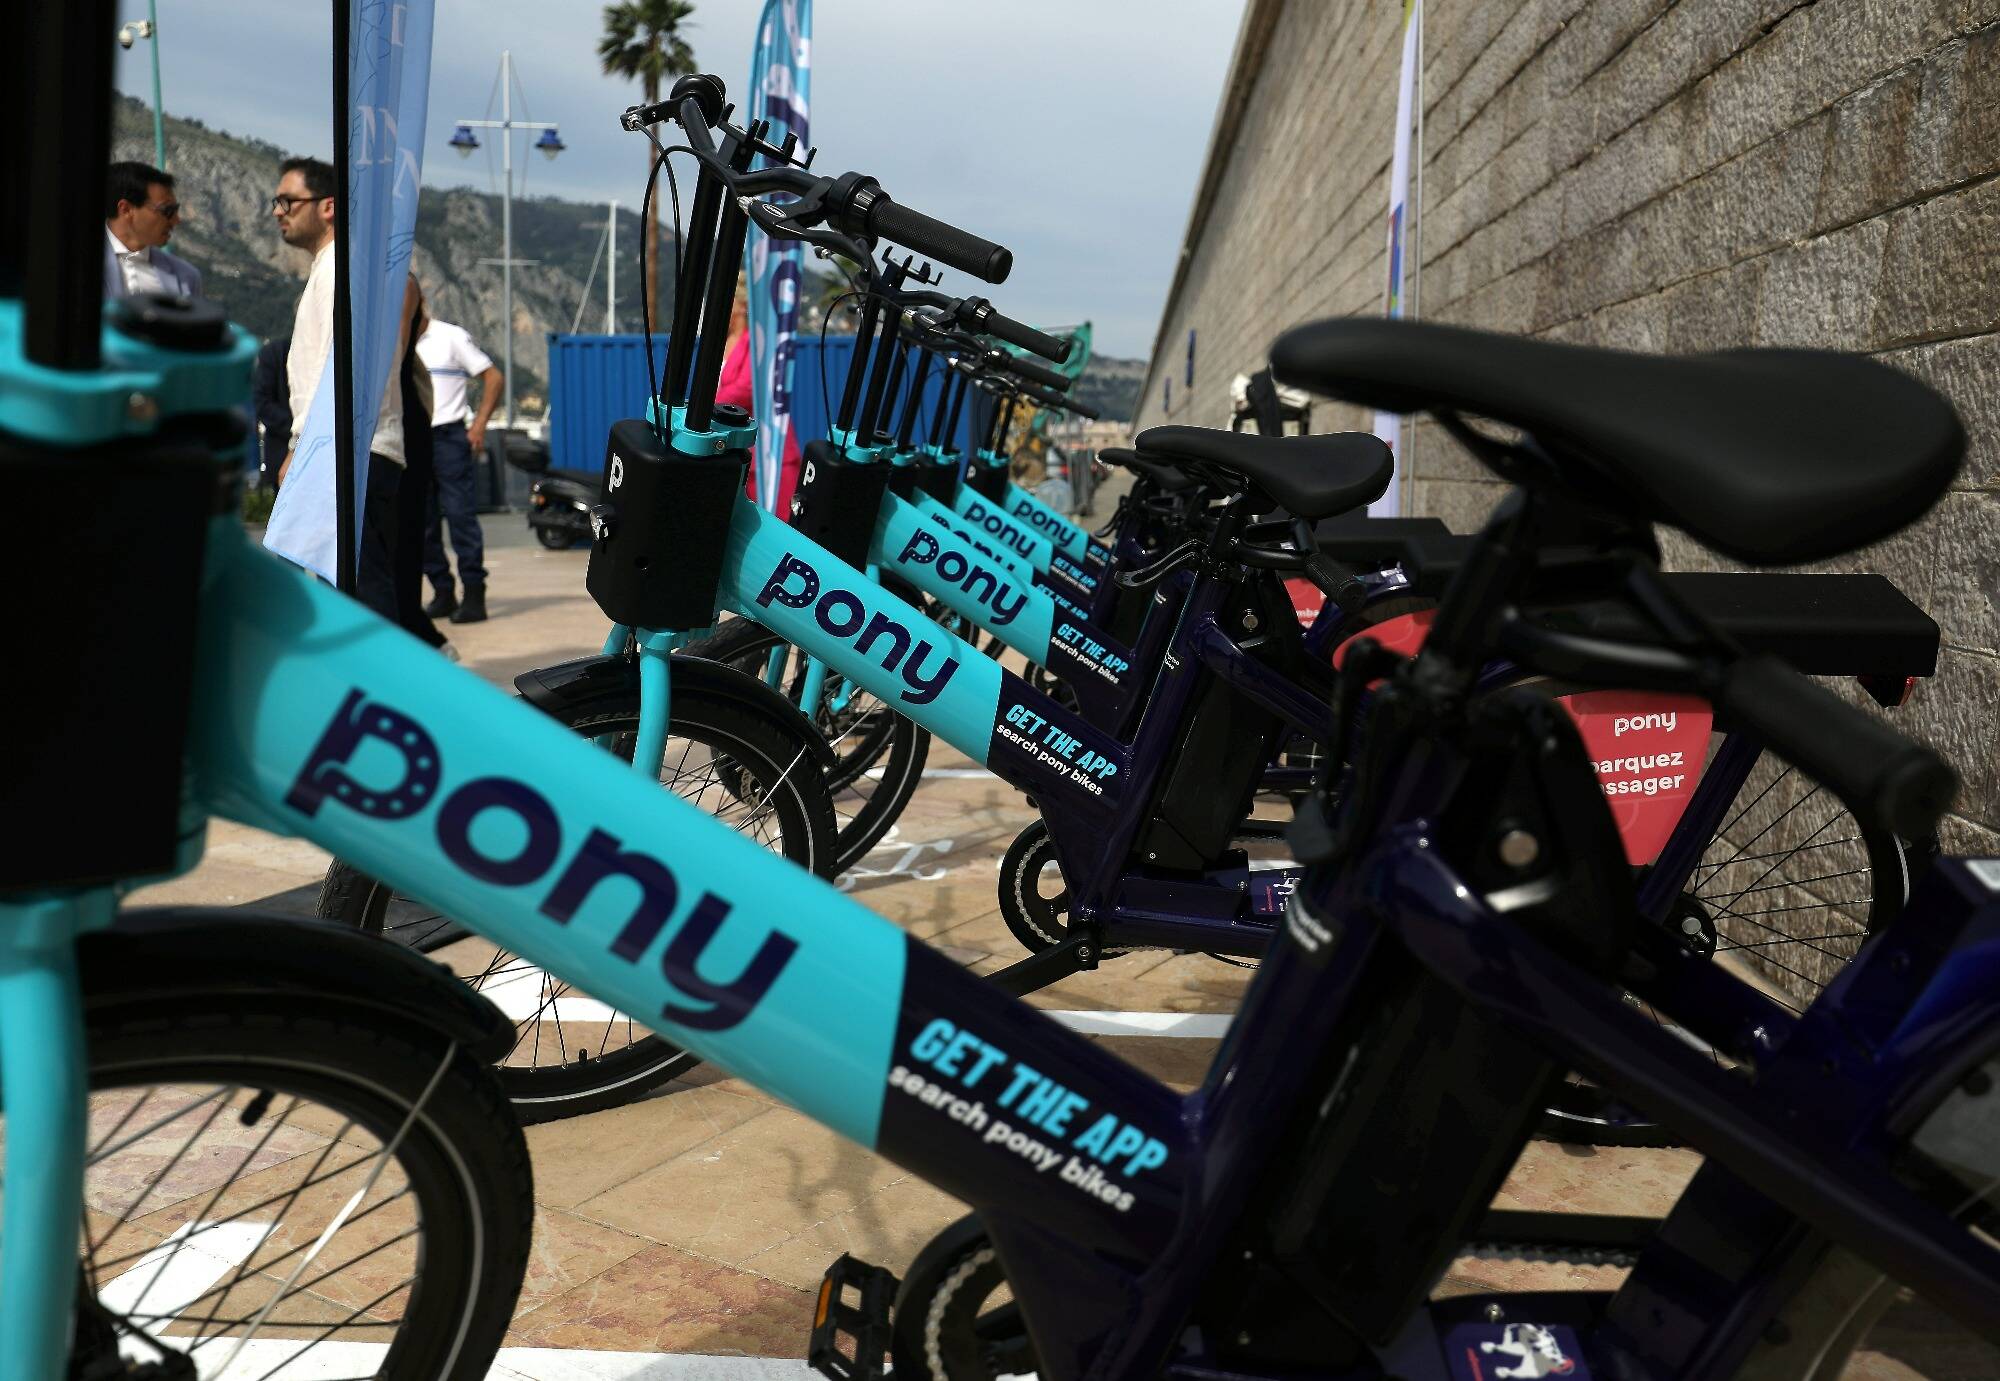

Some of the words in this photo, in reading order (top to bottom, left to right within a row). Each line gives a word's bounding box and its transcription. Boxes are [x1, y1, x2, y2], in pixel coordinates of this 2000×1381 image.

[963, 501, 1037, 558] pony
[1012, 499, 1078, 548] pony
[897, 527, 1028, 625] pony
[755, 551, 960, 705] pony
[1050, 635, 1079, 657] search
[1076, 653, 1099, 671] pony
[1097, 664, 1120, 685] bikes
[1057, 623, 1084, 645] GET
[1079, 637, 1107, 660] THE
[1101, 653, 1129, 674] APP
[996, 724, 1039, 755] search
[1036, 750, 1071, 775] pony
[1070, 768, 1103, 796] bikes
[1005, 704, 1047, 735] GET
[1042, 725, 1083, 760] THE
[1075, 750, 1118, 780] APP
[1614, 711, 1677, 737] pony
[1600, 774, 1685, 796] ssager
[282, 685, 800, 1033] pony
[909, 1017, 1008, 1089] GET
[997, 1061, 1090, 1139] THE
[1072, 1113, 1169, 1178] APP
[888, 1065, 989, 1131] search
[984, 1120, 1063, 1172] pony
[1059, 1155, 1136, 1212] bikes
